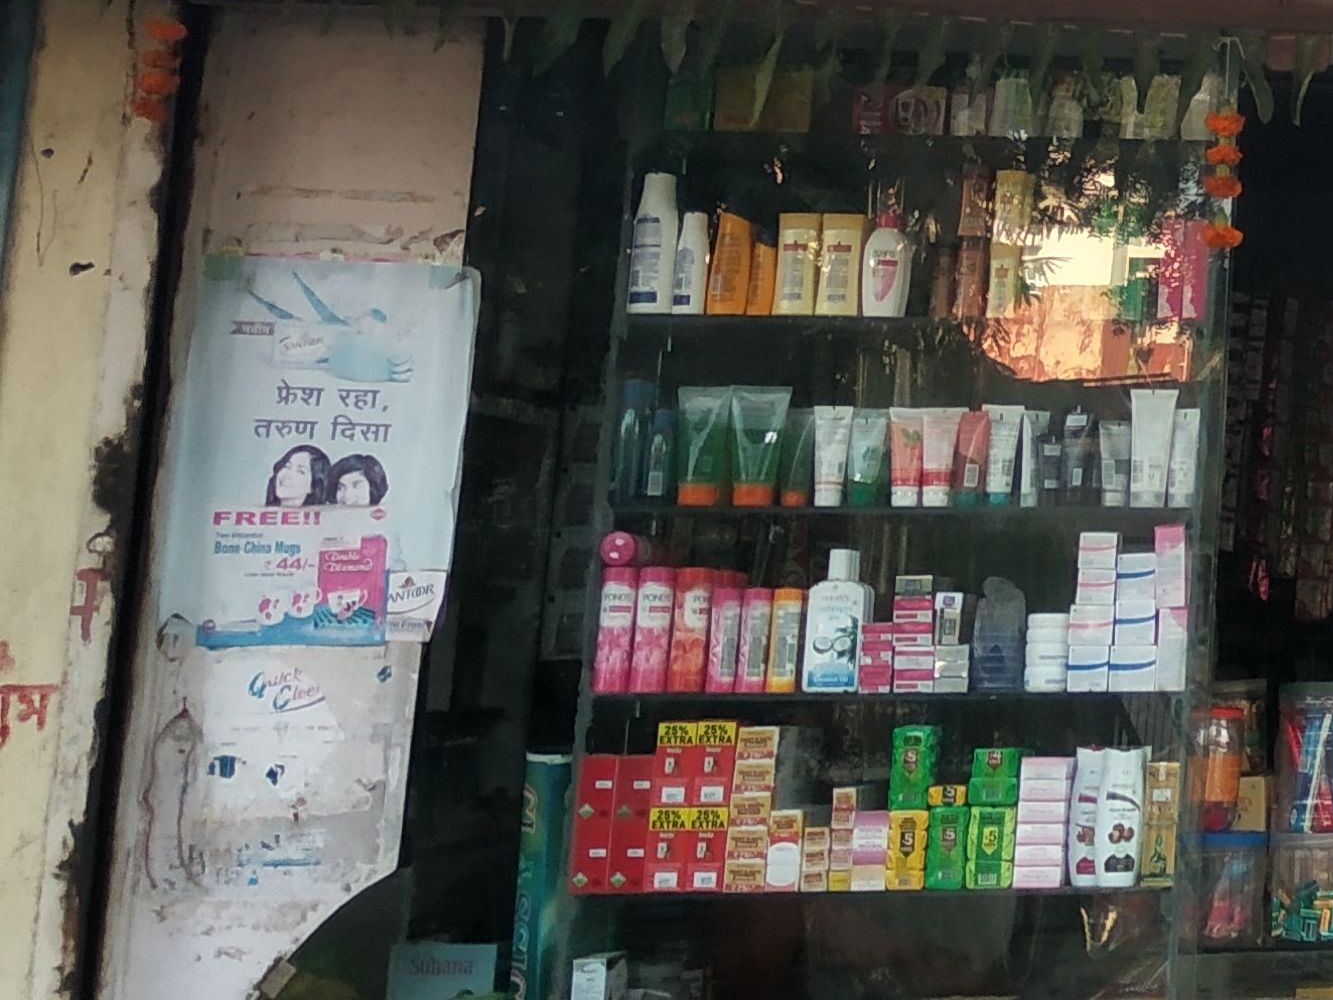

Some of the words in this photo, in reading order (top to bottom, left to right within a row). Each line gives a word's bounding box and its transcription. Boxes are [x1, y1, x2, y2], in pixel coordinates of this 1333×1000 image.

[276, 379, 324, 407] फ्रेश
[338, 388, 390, 412] रहा,
[253, 418, 318, 440] तरुण
[330, 414, 393, 443] दिसा
[213, 510, 321, 526] FREE!!
[214, 541, 241, 554] Bone
[244, 540, 272, 554] China
[275, 540, 302, 557] Mugs
[664, 725, 689, 736] 25%
[704, 724, 729, 735] 25%
[659, 736, 694, 745] EXTRA
[699, 735, 733, 745] EXTRA
[656, 809, 682, 820] 25%
[696, 809, 721, 820] 25%
[651, 820, 686, 830] EXTRA
[691, 820, 726, 830] EXTRA
